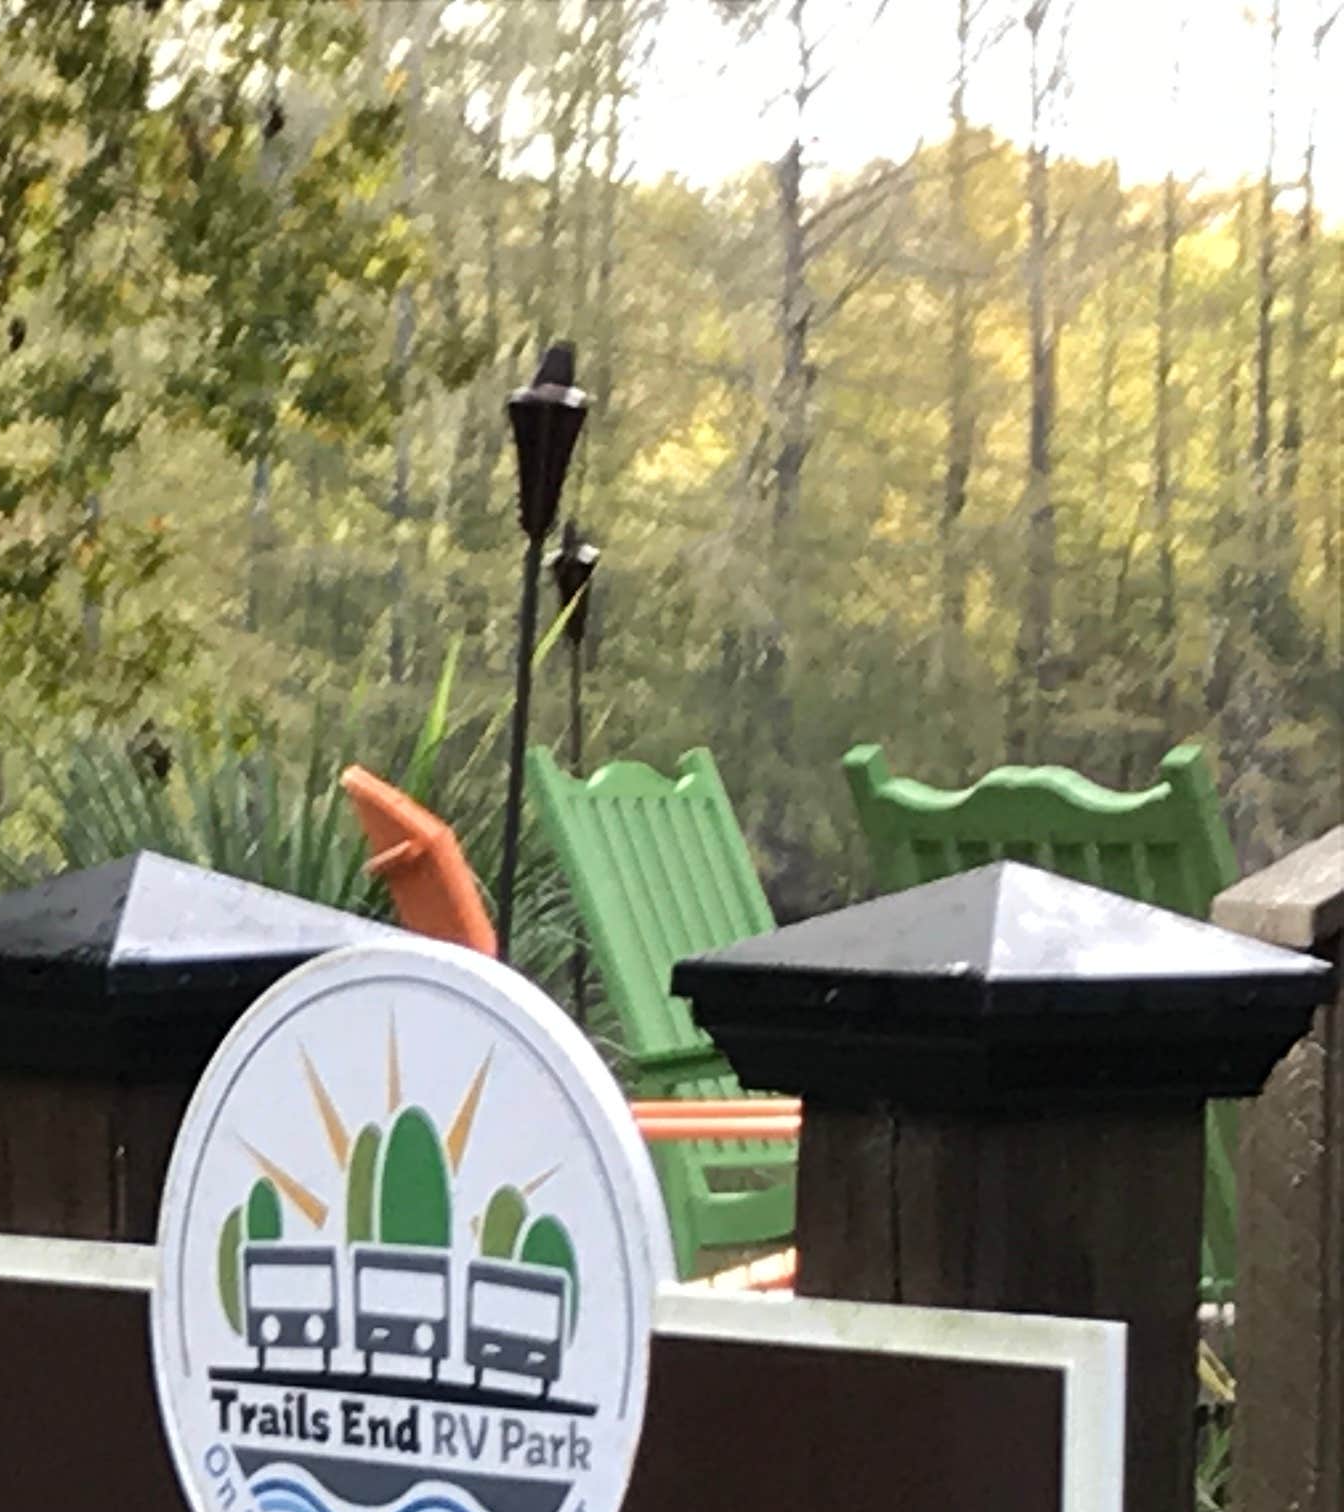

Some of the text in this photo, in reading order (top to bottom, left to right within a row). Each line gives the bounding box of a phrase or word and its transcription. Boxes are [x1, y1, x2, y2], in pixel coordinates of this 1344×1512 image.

[210, 1388, 593, 1472] Trails End RV Park
[203, 1443, 239, 1509] On
